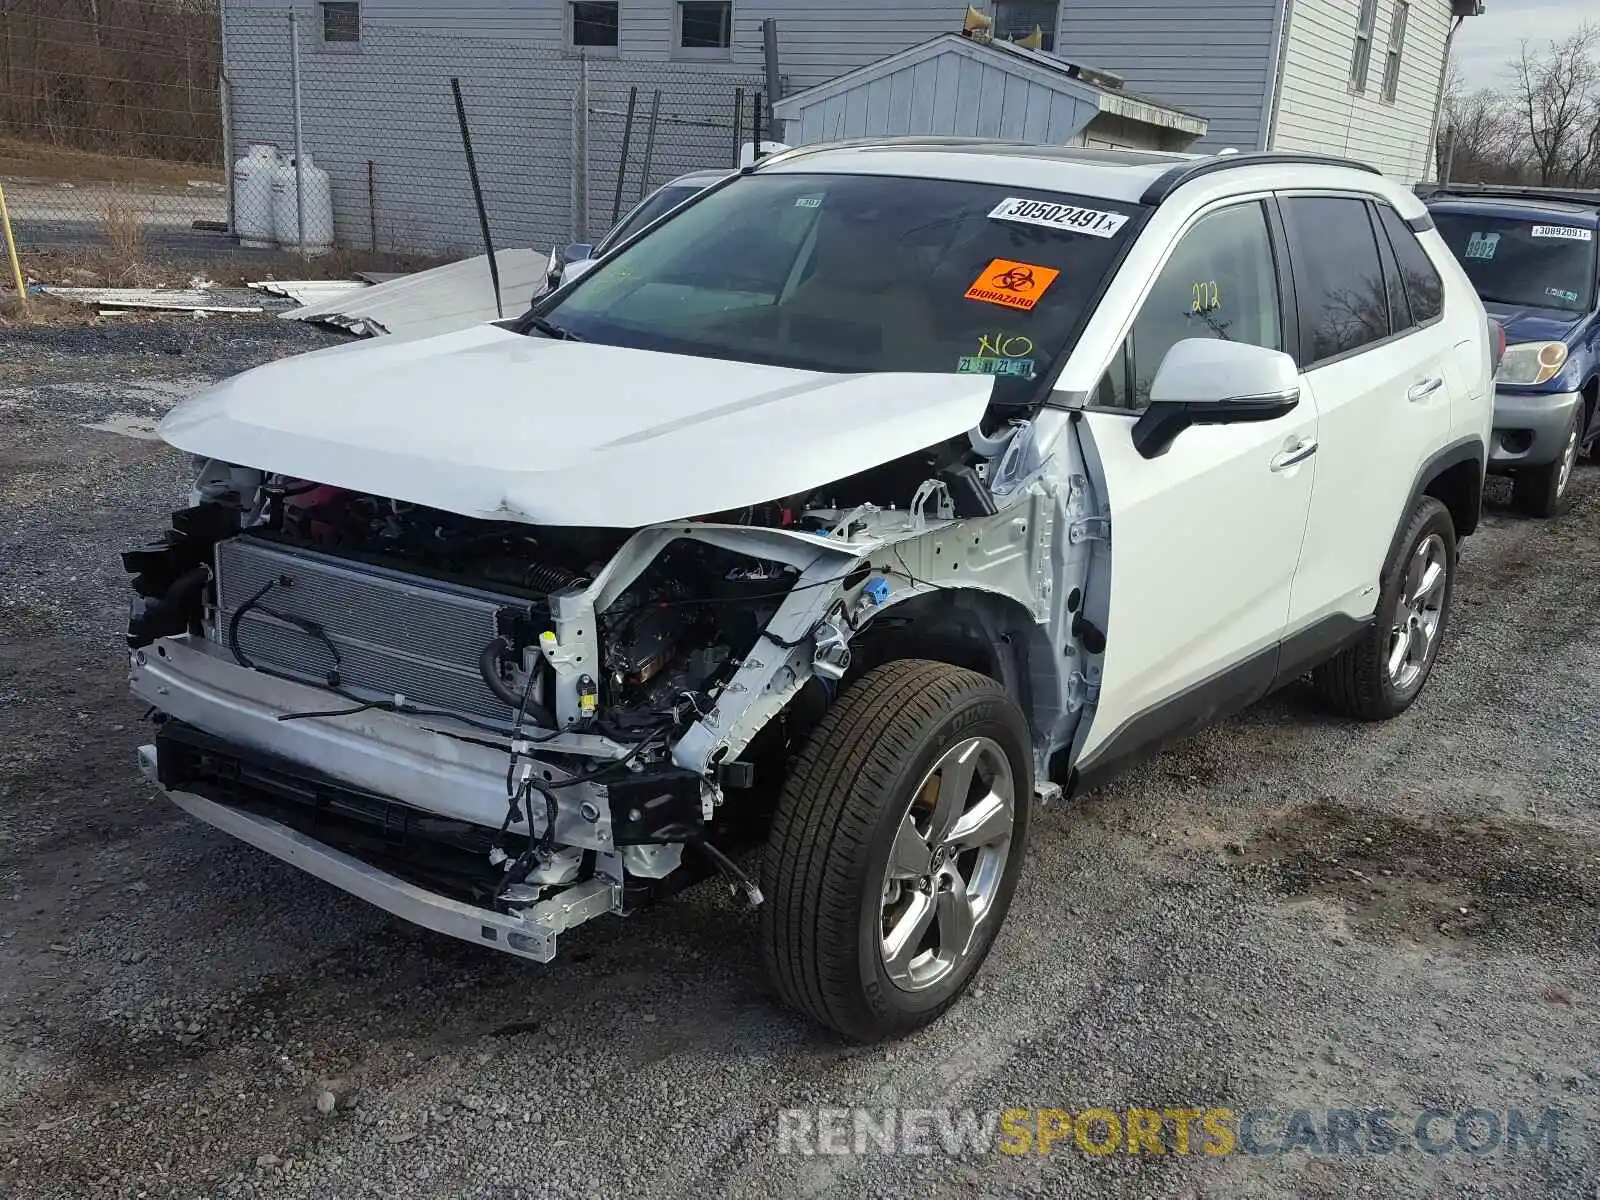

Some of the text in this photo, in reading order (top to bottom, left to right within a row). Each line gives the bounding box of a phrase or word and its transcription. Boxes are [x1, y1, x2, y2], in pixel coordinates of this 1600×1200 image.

[1008, 200, 1109, 230] 30502491
[969, 288, 1034, 307] BIOHAZARD
[1192, 280, 1221, 312] 272
[978, 333, 1033, 358] NO
